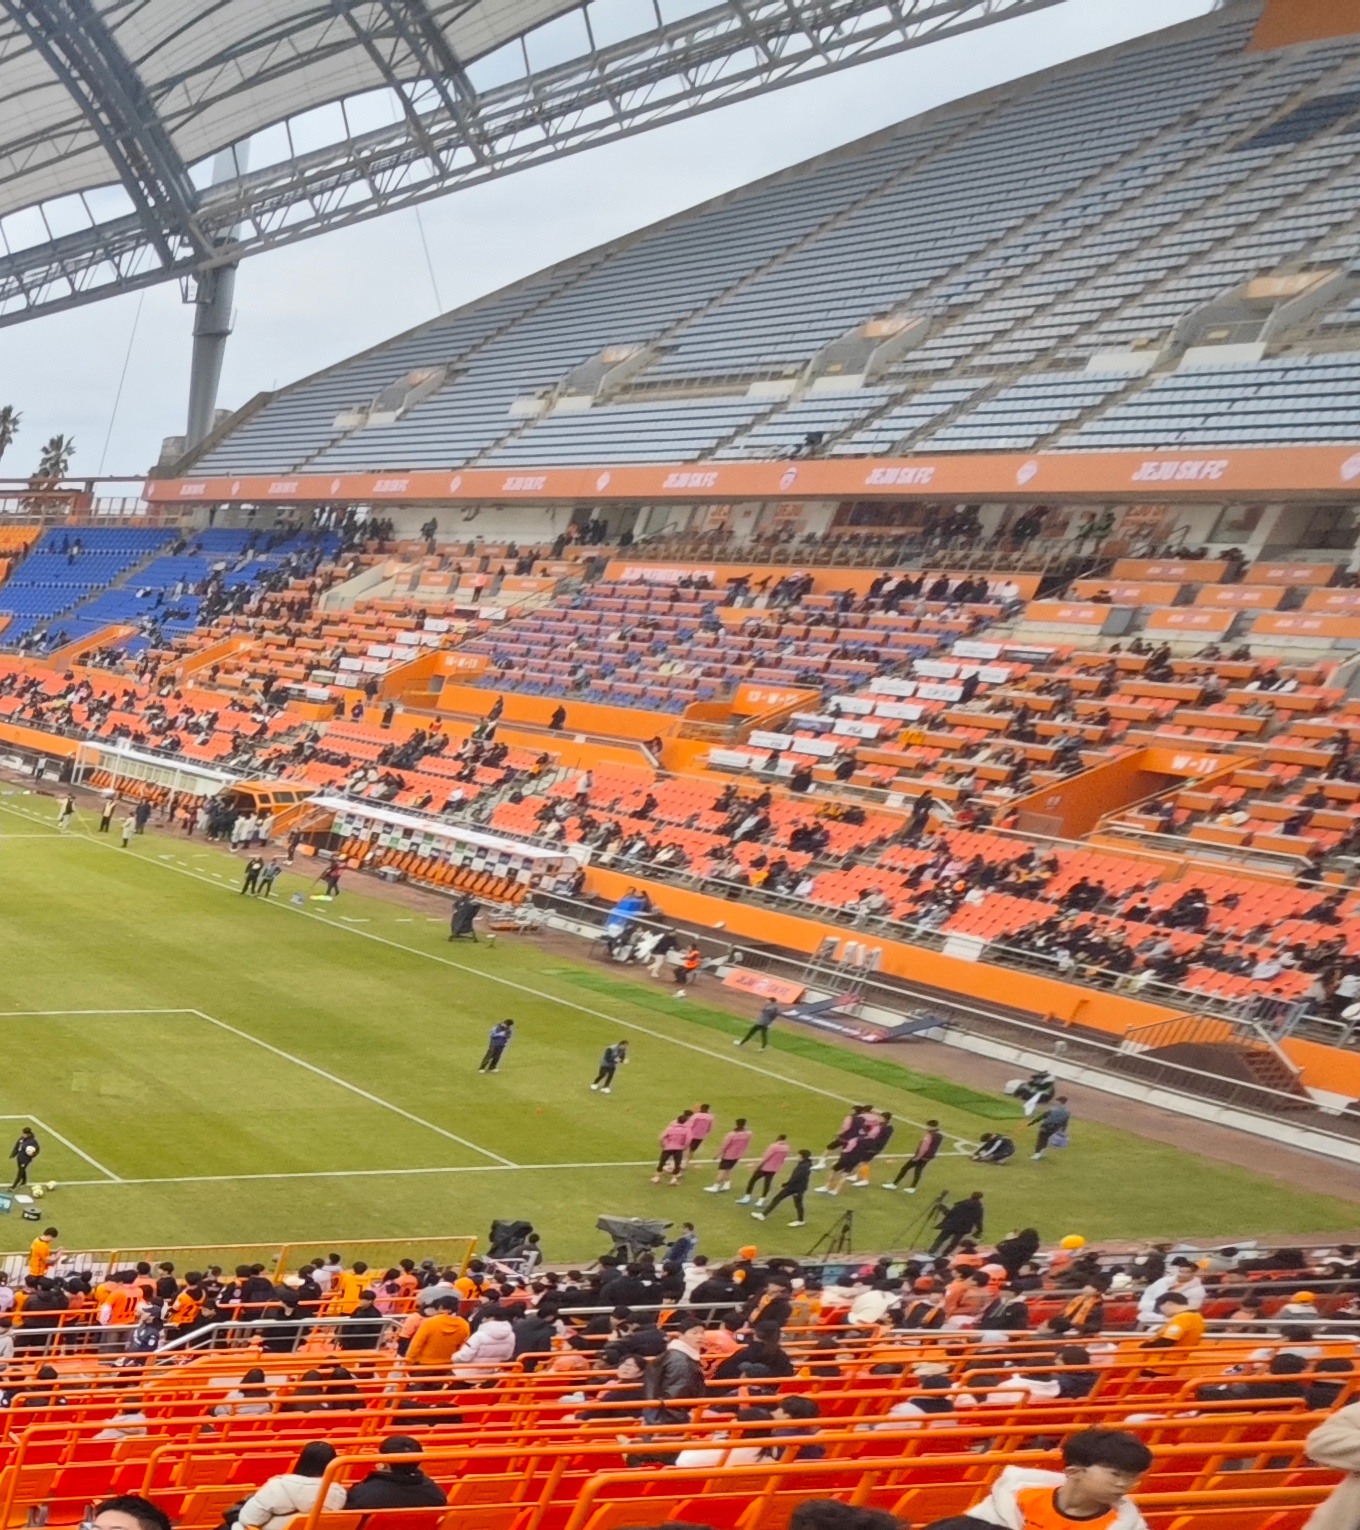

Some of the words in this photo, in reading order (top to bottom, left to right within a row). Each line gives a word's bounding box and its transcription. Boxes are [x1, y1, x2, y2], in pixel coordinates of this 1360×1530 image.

[864, 466, 896, 485] JEJU
[1131, 459, 1176, 482] JEJU
[1176, 459, 1201, 482] SK
[1202, 459, 1229, 482] FC
[1171, 755, 1219, 774] W-11
